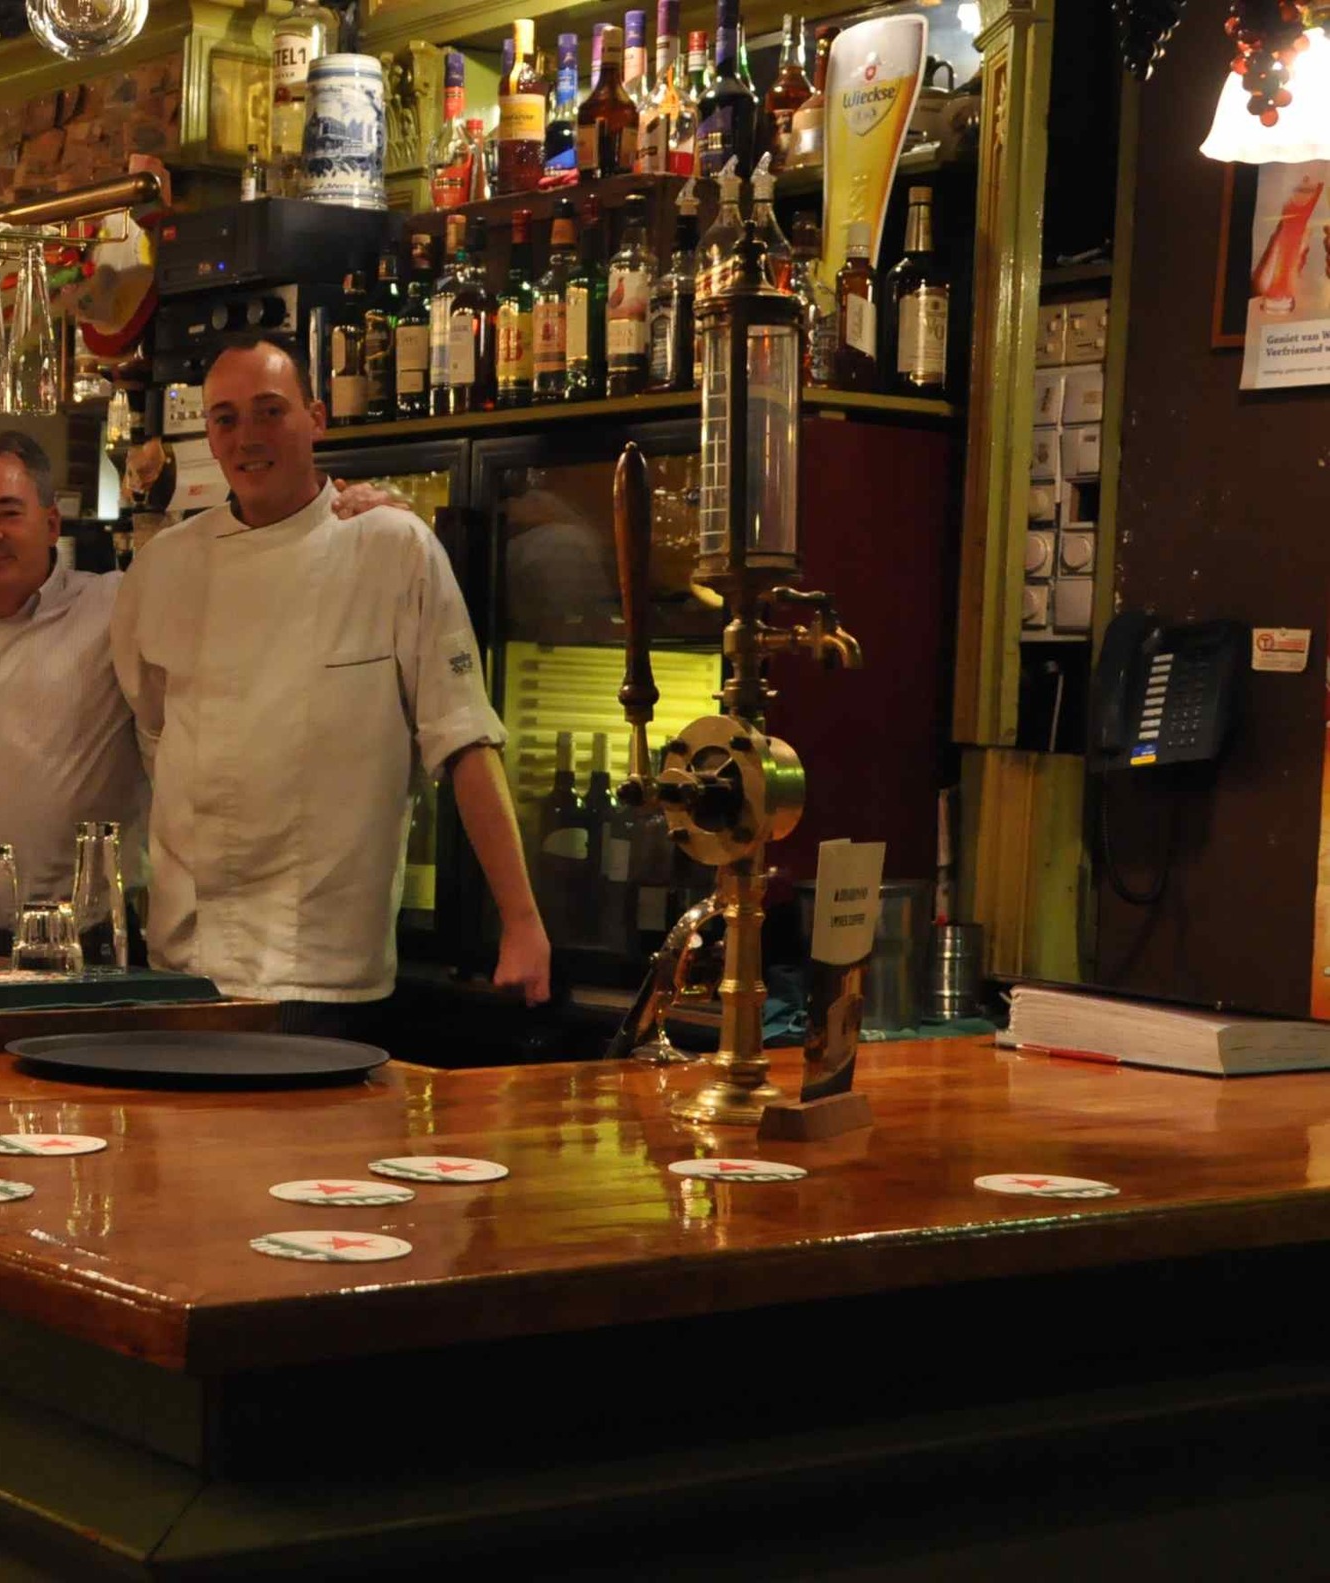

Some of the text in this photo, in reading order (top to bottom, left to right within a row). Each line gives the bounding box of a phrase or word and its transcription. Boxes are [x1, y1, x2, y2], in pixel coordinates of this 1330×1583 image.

[273, 47, 297, 66] TEL
[842, 86, 896, 109] Wieckse
[1267, 333, 1299, 344] Geniet
[1302, 333, 1319, 342] van
[1266, 344, 1323, 356] Verfrissend
